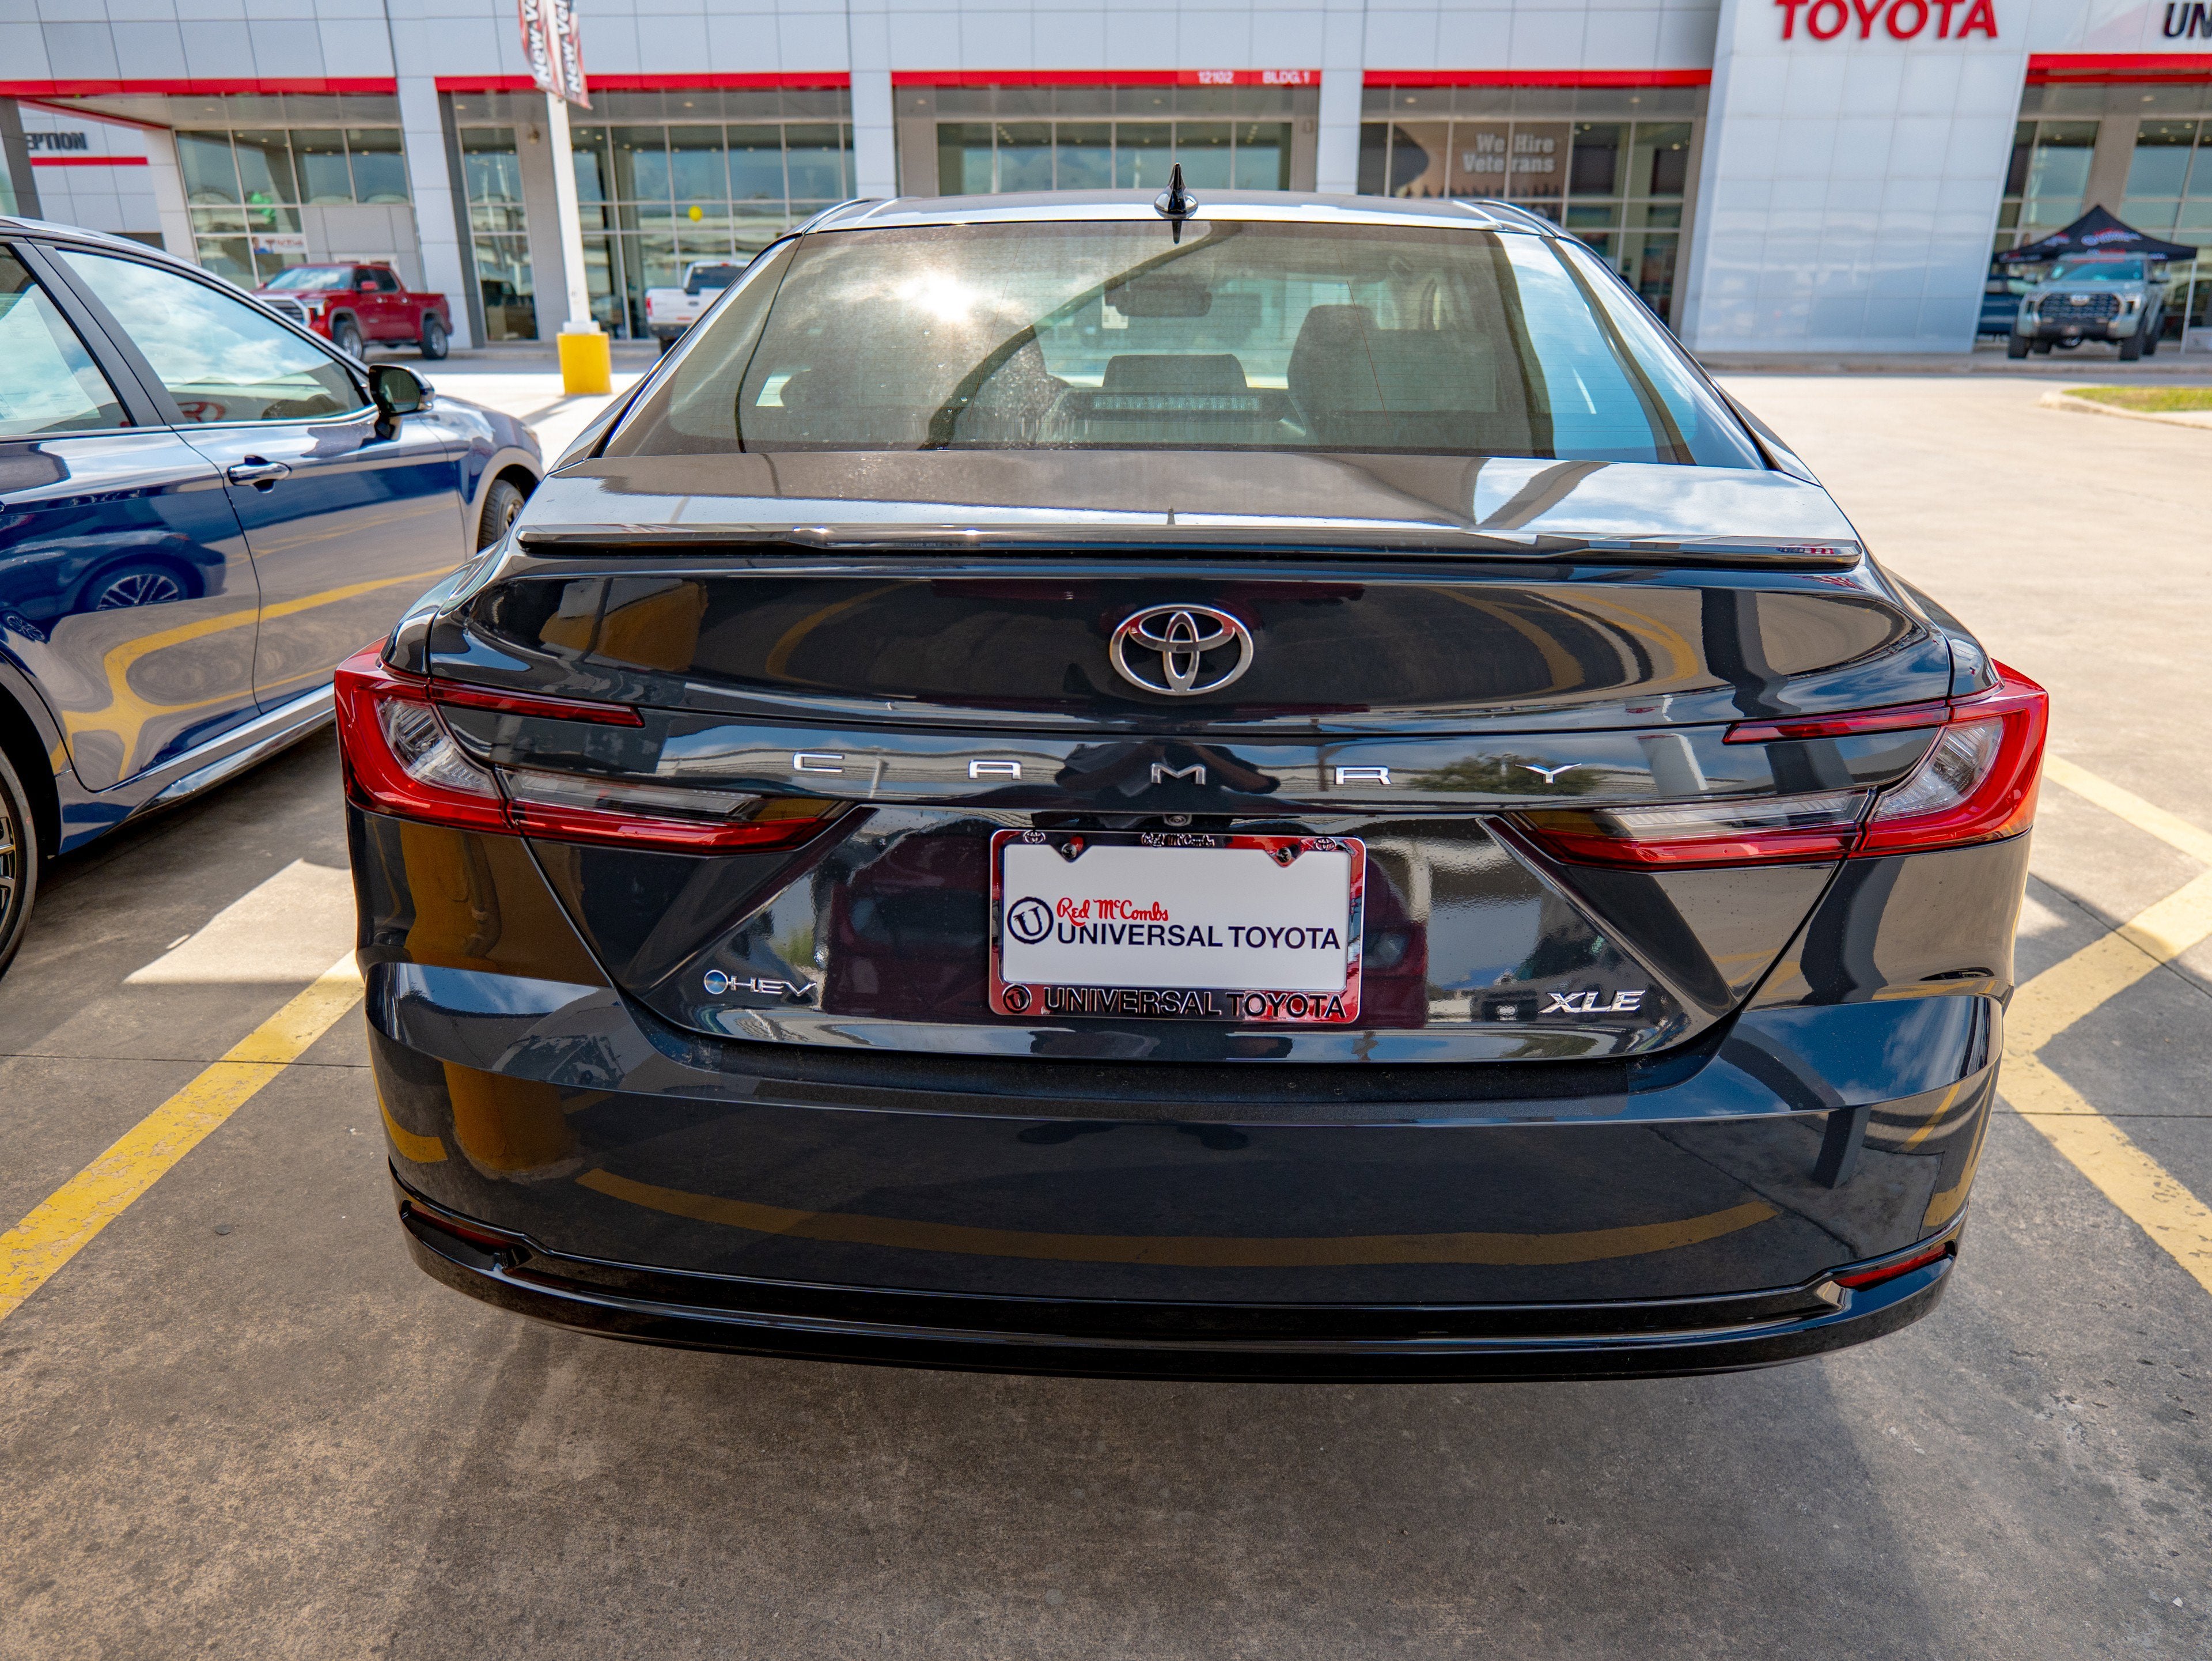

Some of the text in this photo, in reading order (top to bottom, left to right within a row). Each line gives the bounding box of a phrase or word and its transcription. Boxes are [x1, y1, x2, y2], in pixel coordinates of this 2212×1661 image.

[1774, 0, 1998, 39] TOYOTA
[529, 27, 552, 82] New
[562, 41, 581, 93] New
[1198, 70, 1234, 84] 12102
[1476, 133, 1554, 153] We Hire
[1463, 153, 1554, 172] Veterans
[792, 752, 1582, 785] CAMRY
[1141, 833, 1165, 847] Red
[1056, 897, 1169, 926] Red McCombs
[1058, 922, 1340, 949] UNIVERSAL TOYOTA
[731, 975, 817, 997] HEV
[1043, 986, 1347, 1019] UNIVERSAL TOYOTA
[1537, 990, 1646, 1013] XLE
